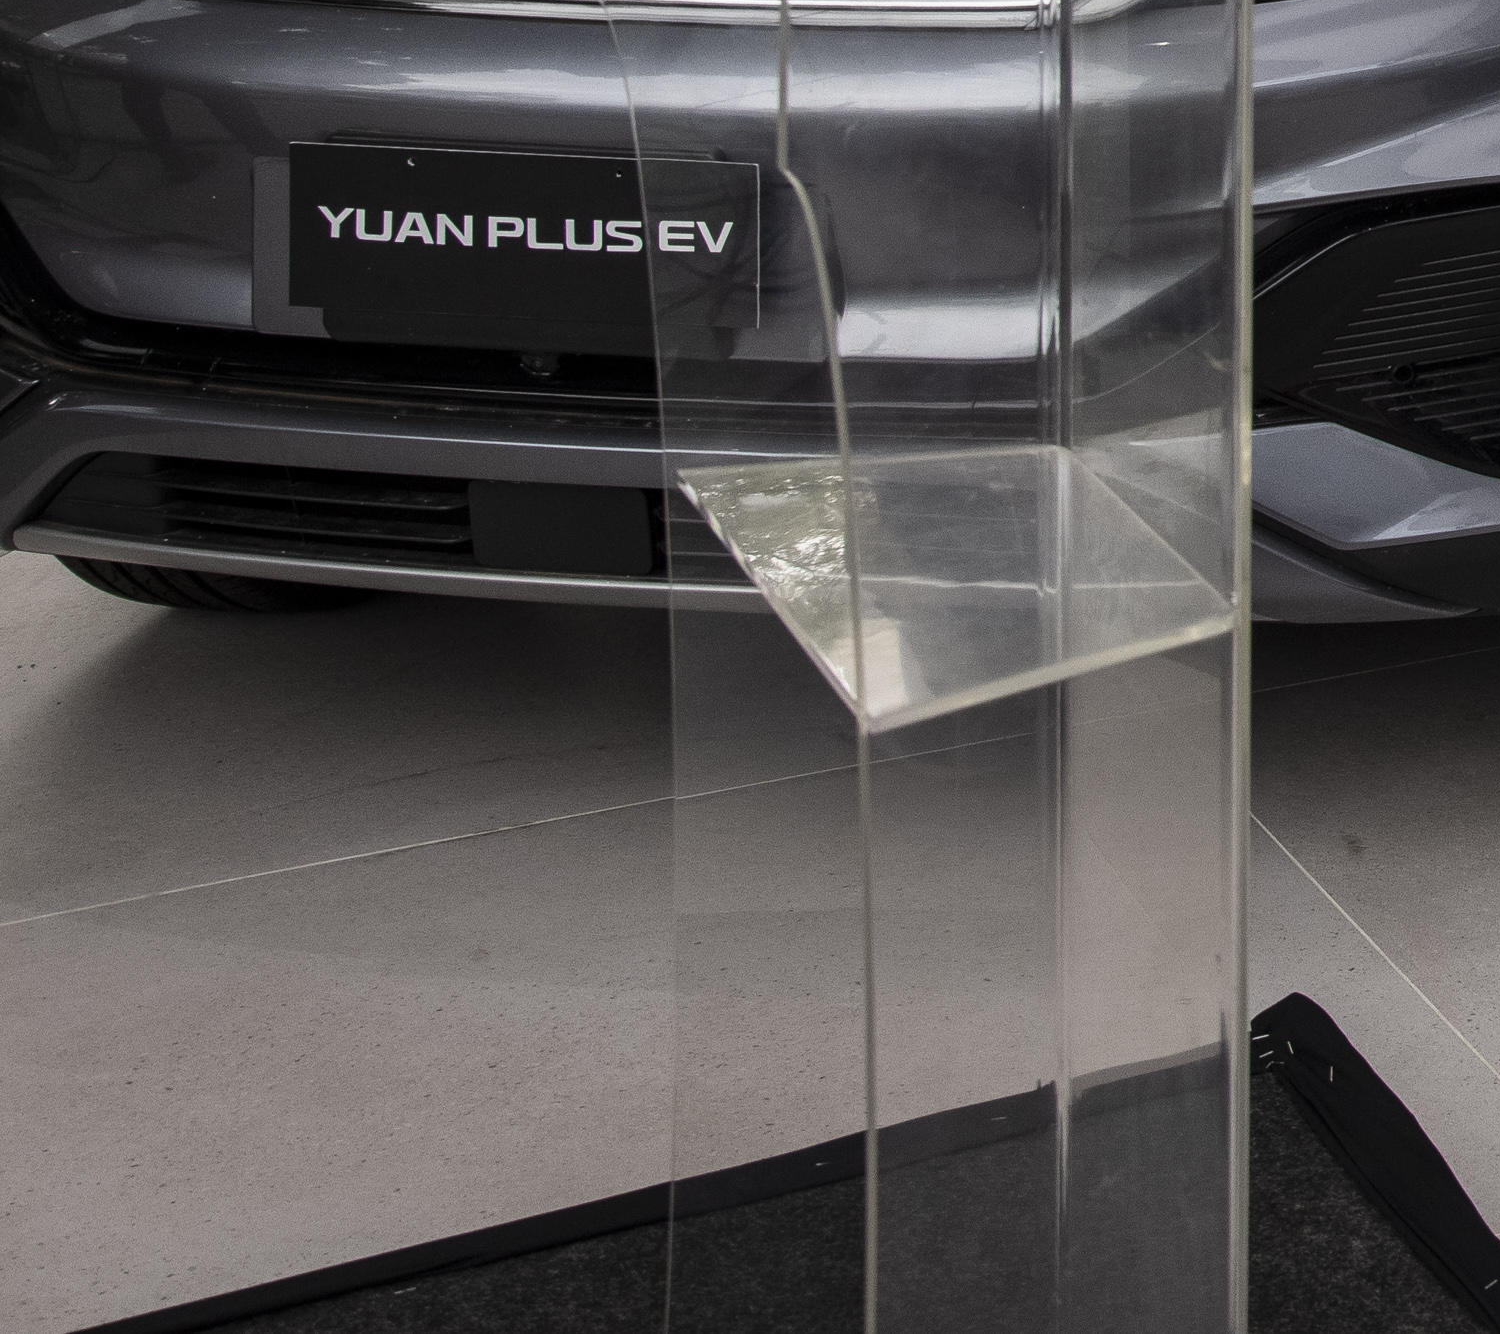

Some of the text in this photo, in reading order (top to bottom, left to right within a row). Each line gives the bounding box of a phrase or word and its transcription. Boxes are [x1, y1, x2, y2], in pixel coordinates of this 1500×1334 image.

[317, 205, 734, 253] YUAN PLUS EV
